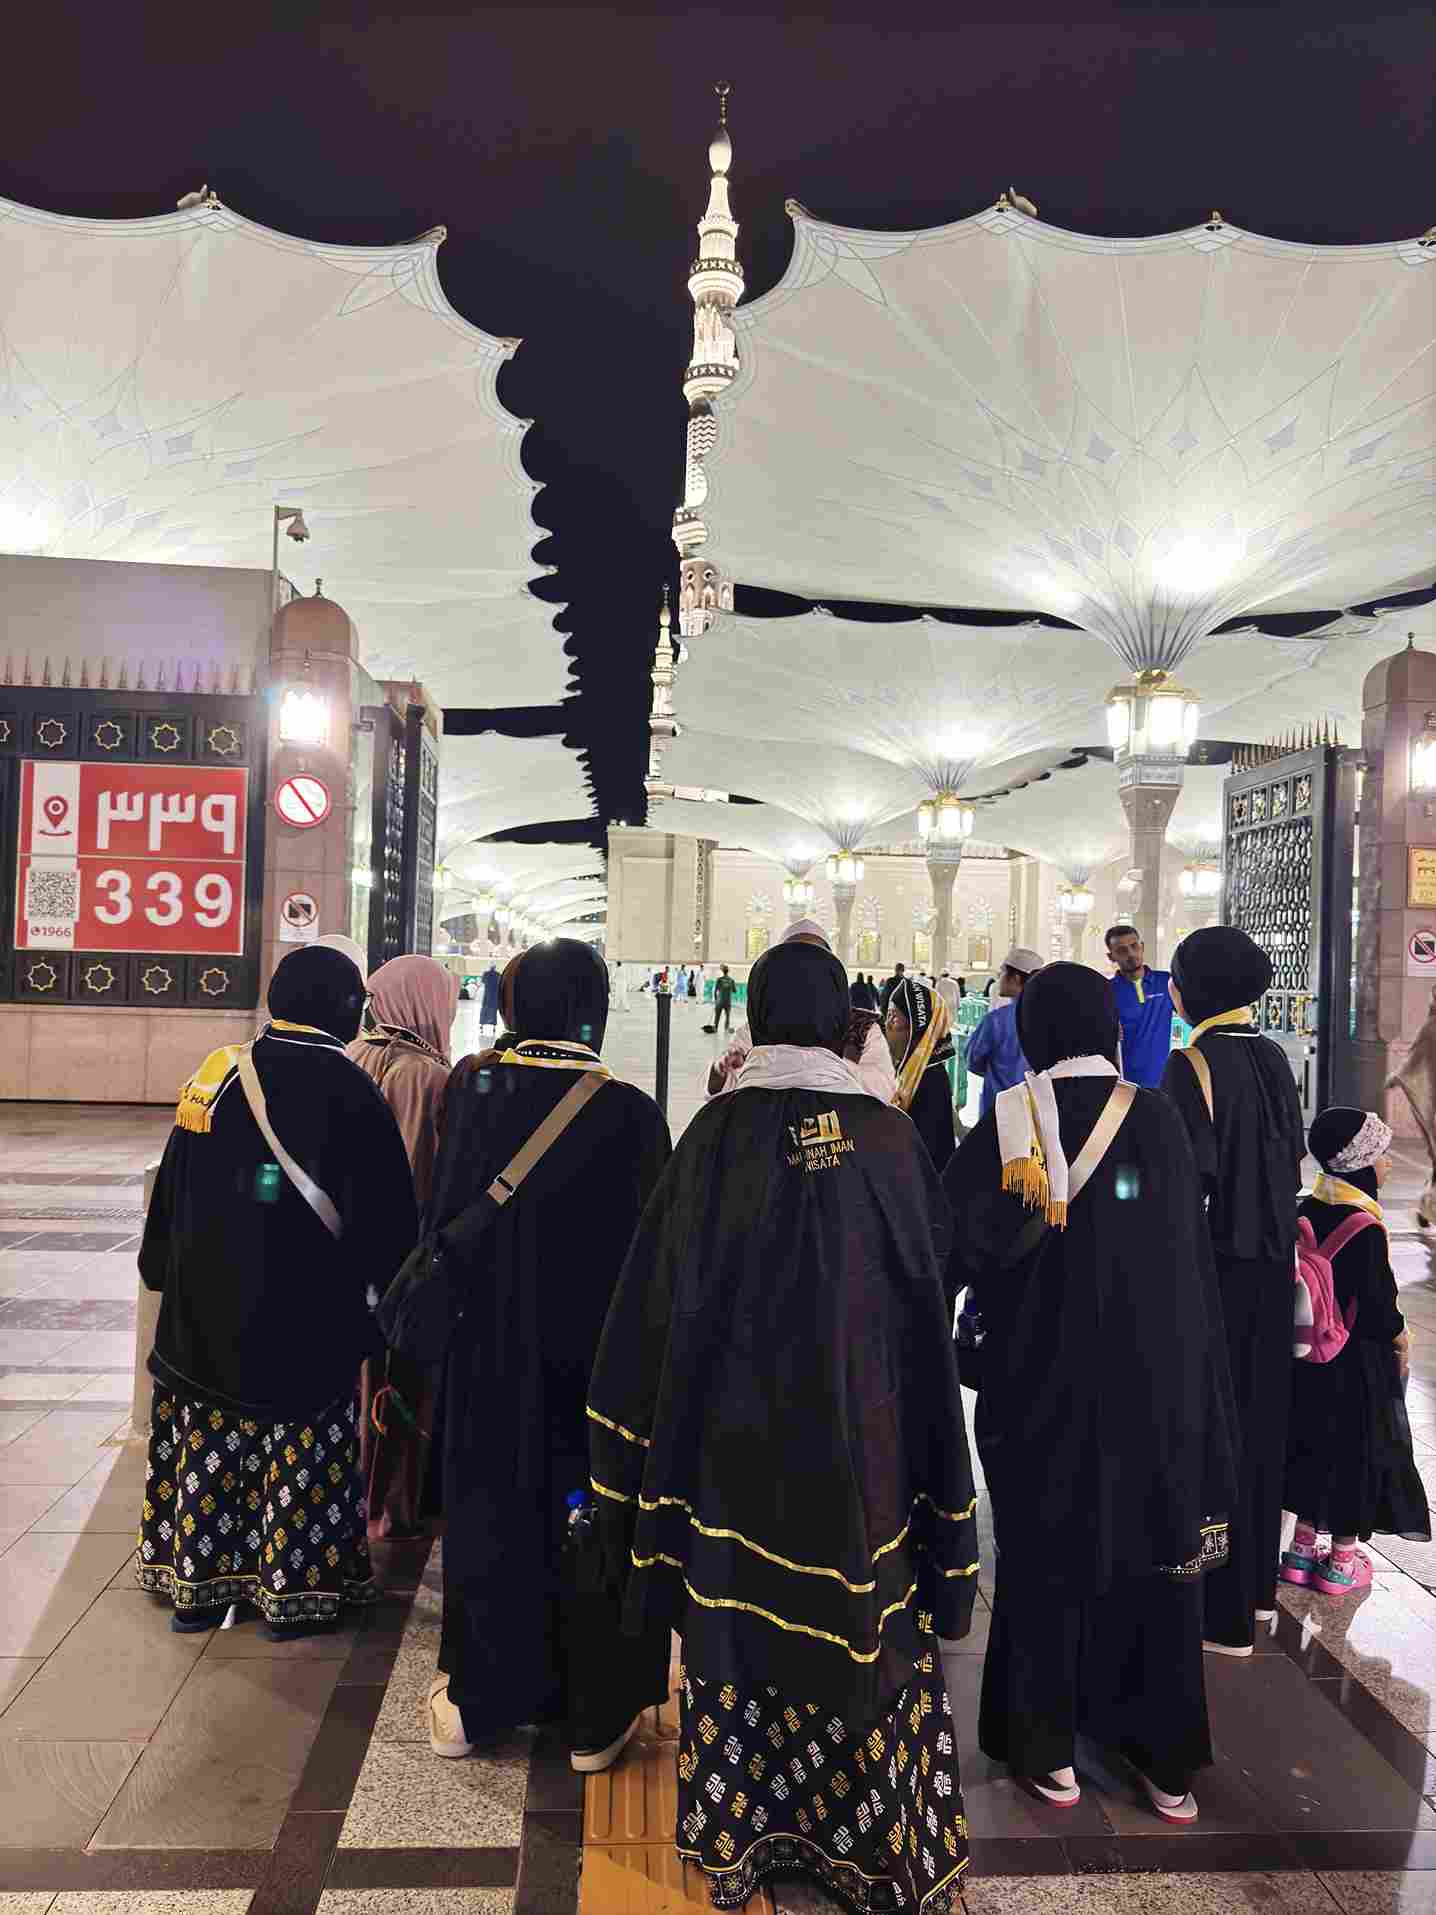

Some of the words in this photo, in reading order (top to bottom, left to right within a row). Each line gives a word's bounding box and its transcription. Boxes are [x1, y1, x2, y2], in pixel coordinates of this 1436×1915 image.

[96, 790, 238, 855] ٣٣٩
[93, 869, 234, 928] 339
[41, 926, 72, 938] 1966
[914, 991, 927, 1027] WISATA
[830, 1138, 855, 1154] IMAN
[804, 1154, 841, 1173] WISATA
